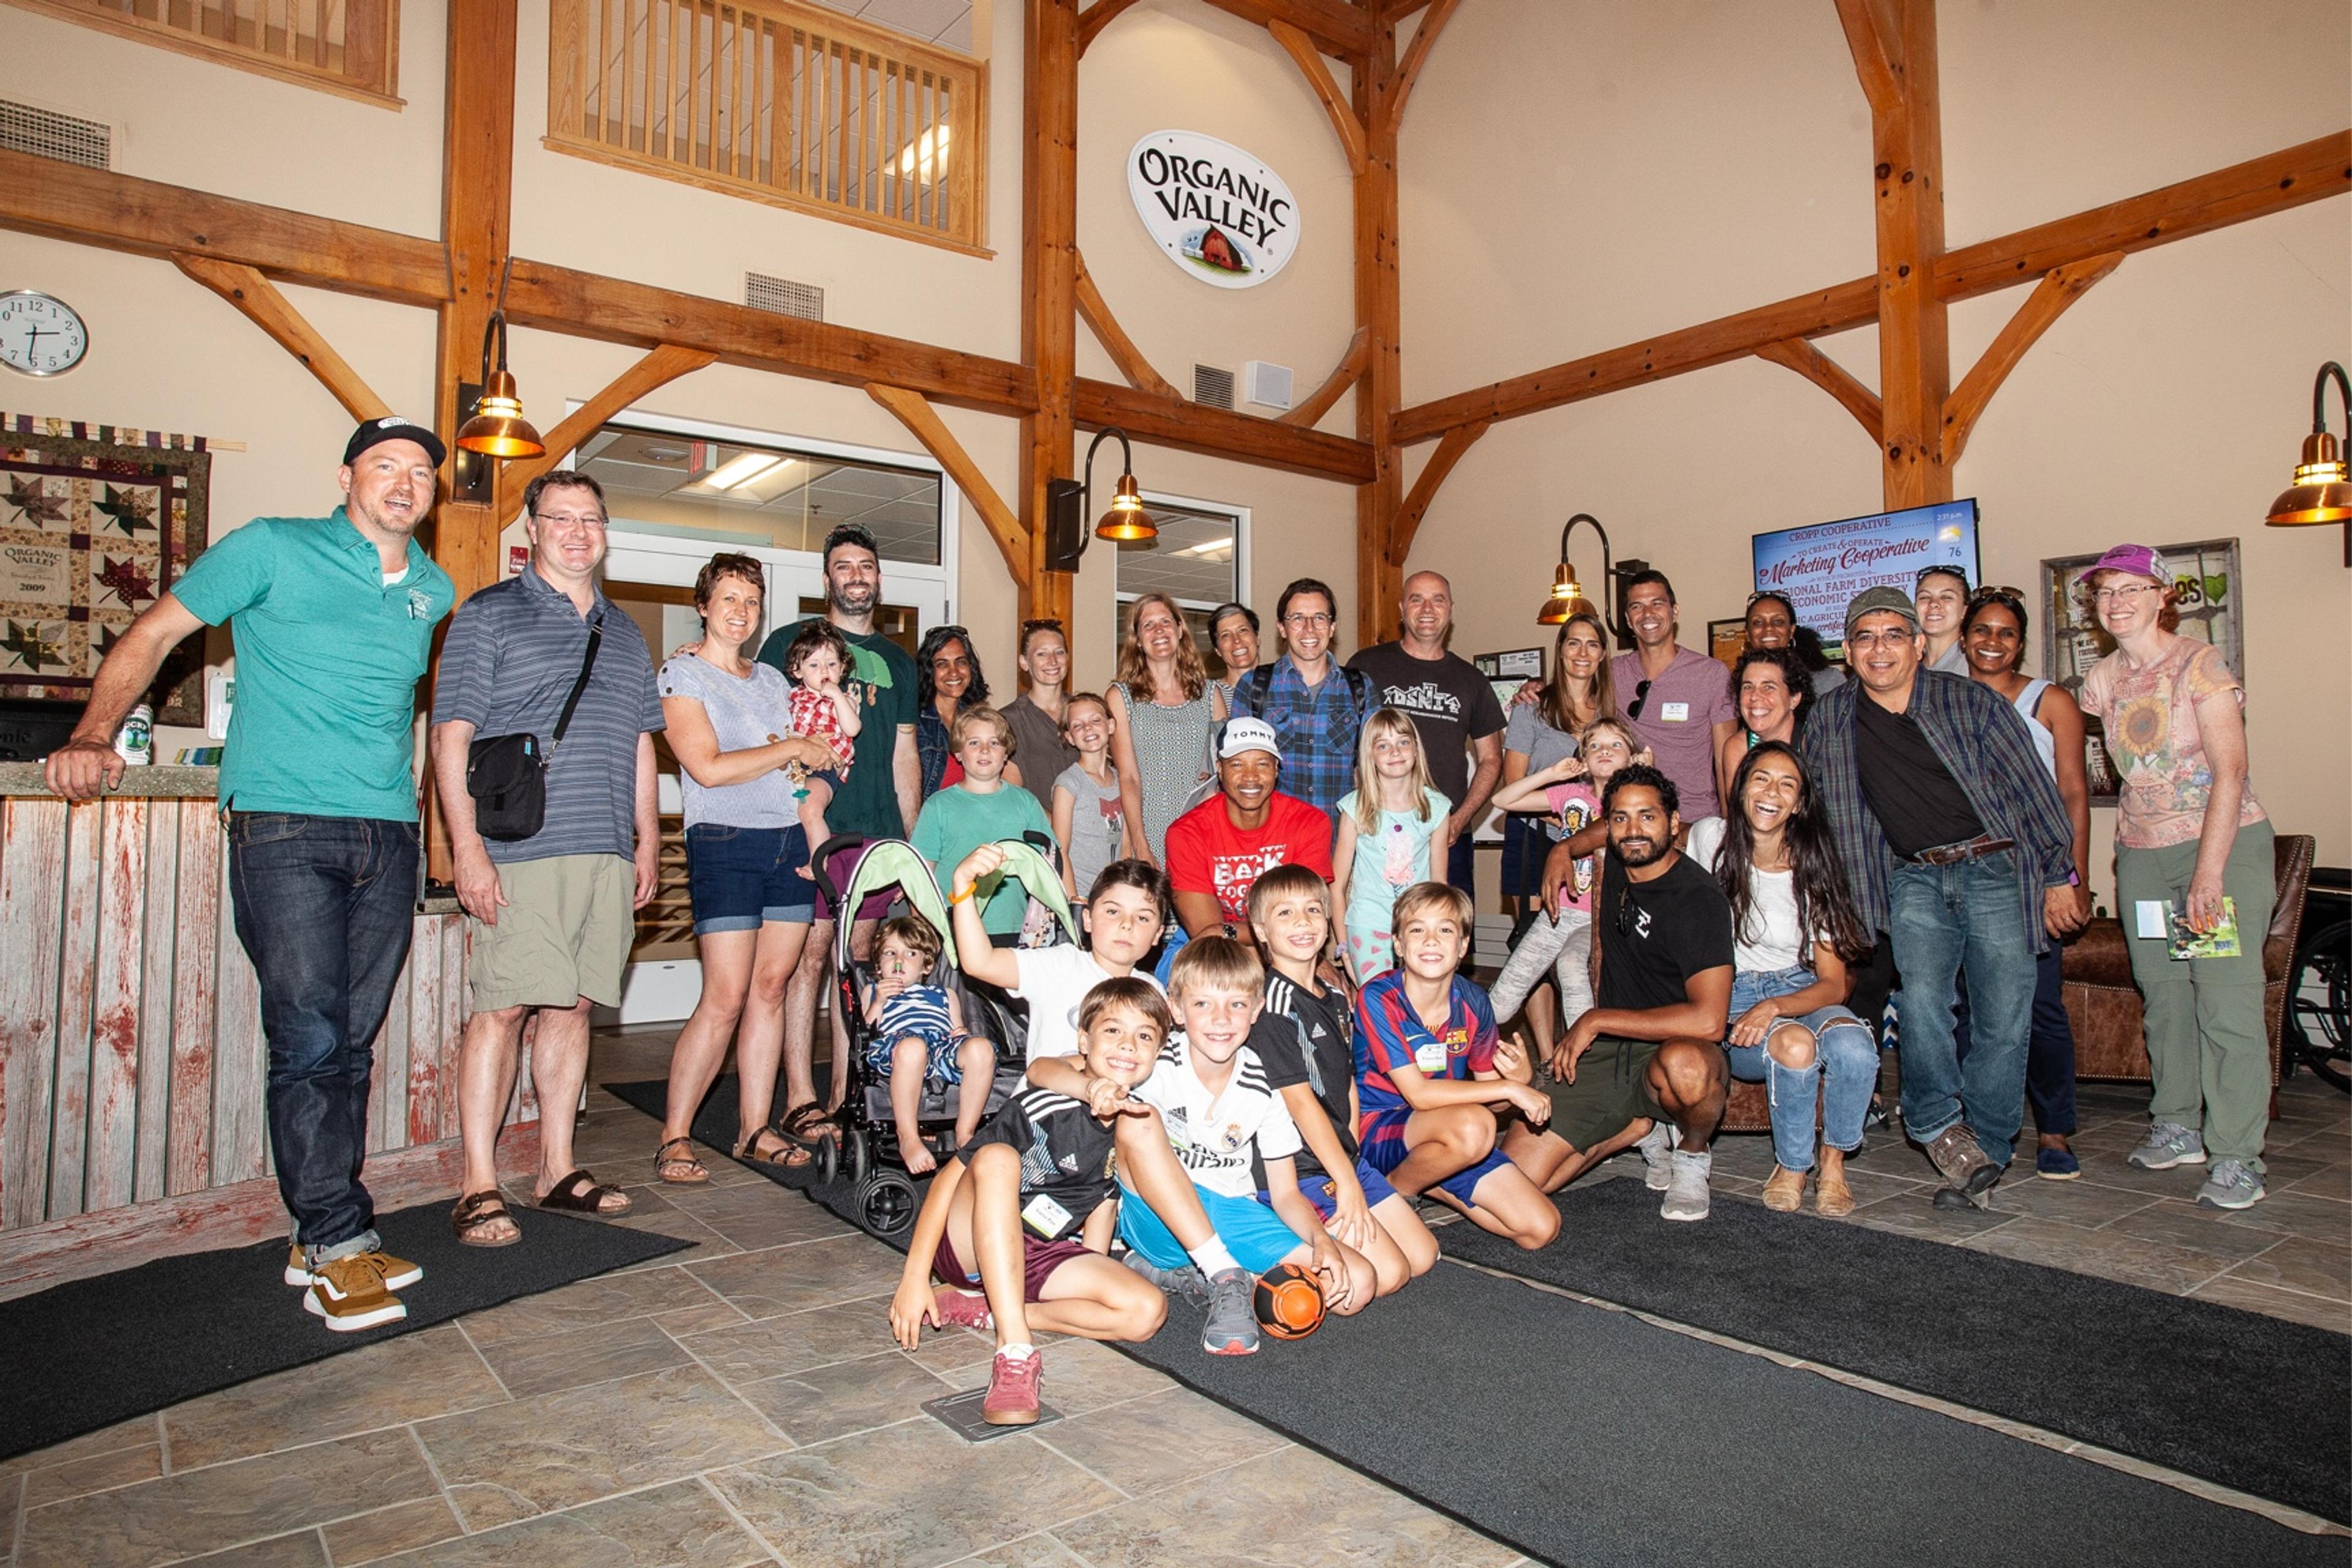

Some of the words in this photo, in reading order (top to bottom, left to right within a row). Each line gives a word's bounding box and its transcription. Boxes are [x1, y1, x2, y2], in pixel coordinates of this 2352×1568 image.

[1139, 148, 1290, 227] ORGANIC
[1154, 187, 1276, 248] VALLEY
[10, 302, 22, 312] 11
[29, 301, 43, 312] 12
[0, 311, 10, 320] 0
[51, 307, 57, 318] 1
[65, 320, 72, 331] 2
[70, 336, 78, 346] 3
[11, 350, 18, 360] 7
[62, 349, 70, 358] 4
[31, 357, 38, 367] 6
[49, 356, 56, 366] 5
[1789, 529, 1819, 542] CROPP
[1821, 517, 1891, 536] COOPERATIVE
[1809, 542, 1836, 555] CREATE
[1838, 539, 1848, 551] &
[1949, 547, 1962, 557] 76
[5, 548, 62, 561] ORGANIC
[12, 557, 58, 567] VALLEY
[1760, 556, 1836, 584] Marketing
[1839, 538, 1929, 570] Cooperative
[20, 582, 46, 592] 2009
[1825, 579, 1856, 592] FARM
[1860, 571, 1919, 587] DIVERSITY
[1792, 592, 1847, 608] ECONOMIC
[1808, 612, 1845, 623] AGRICUL
[1234, 730, 1272, 740] TOMMY
